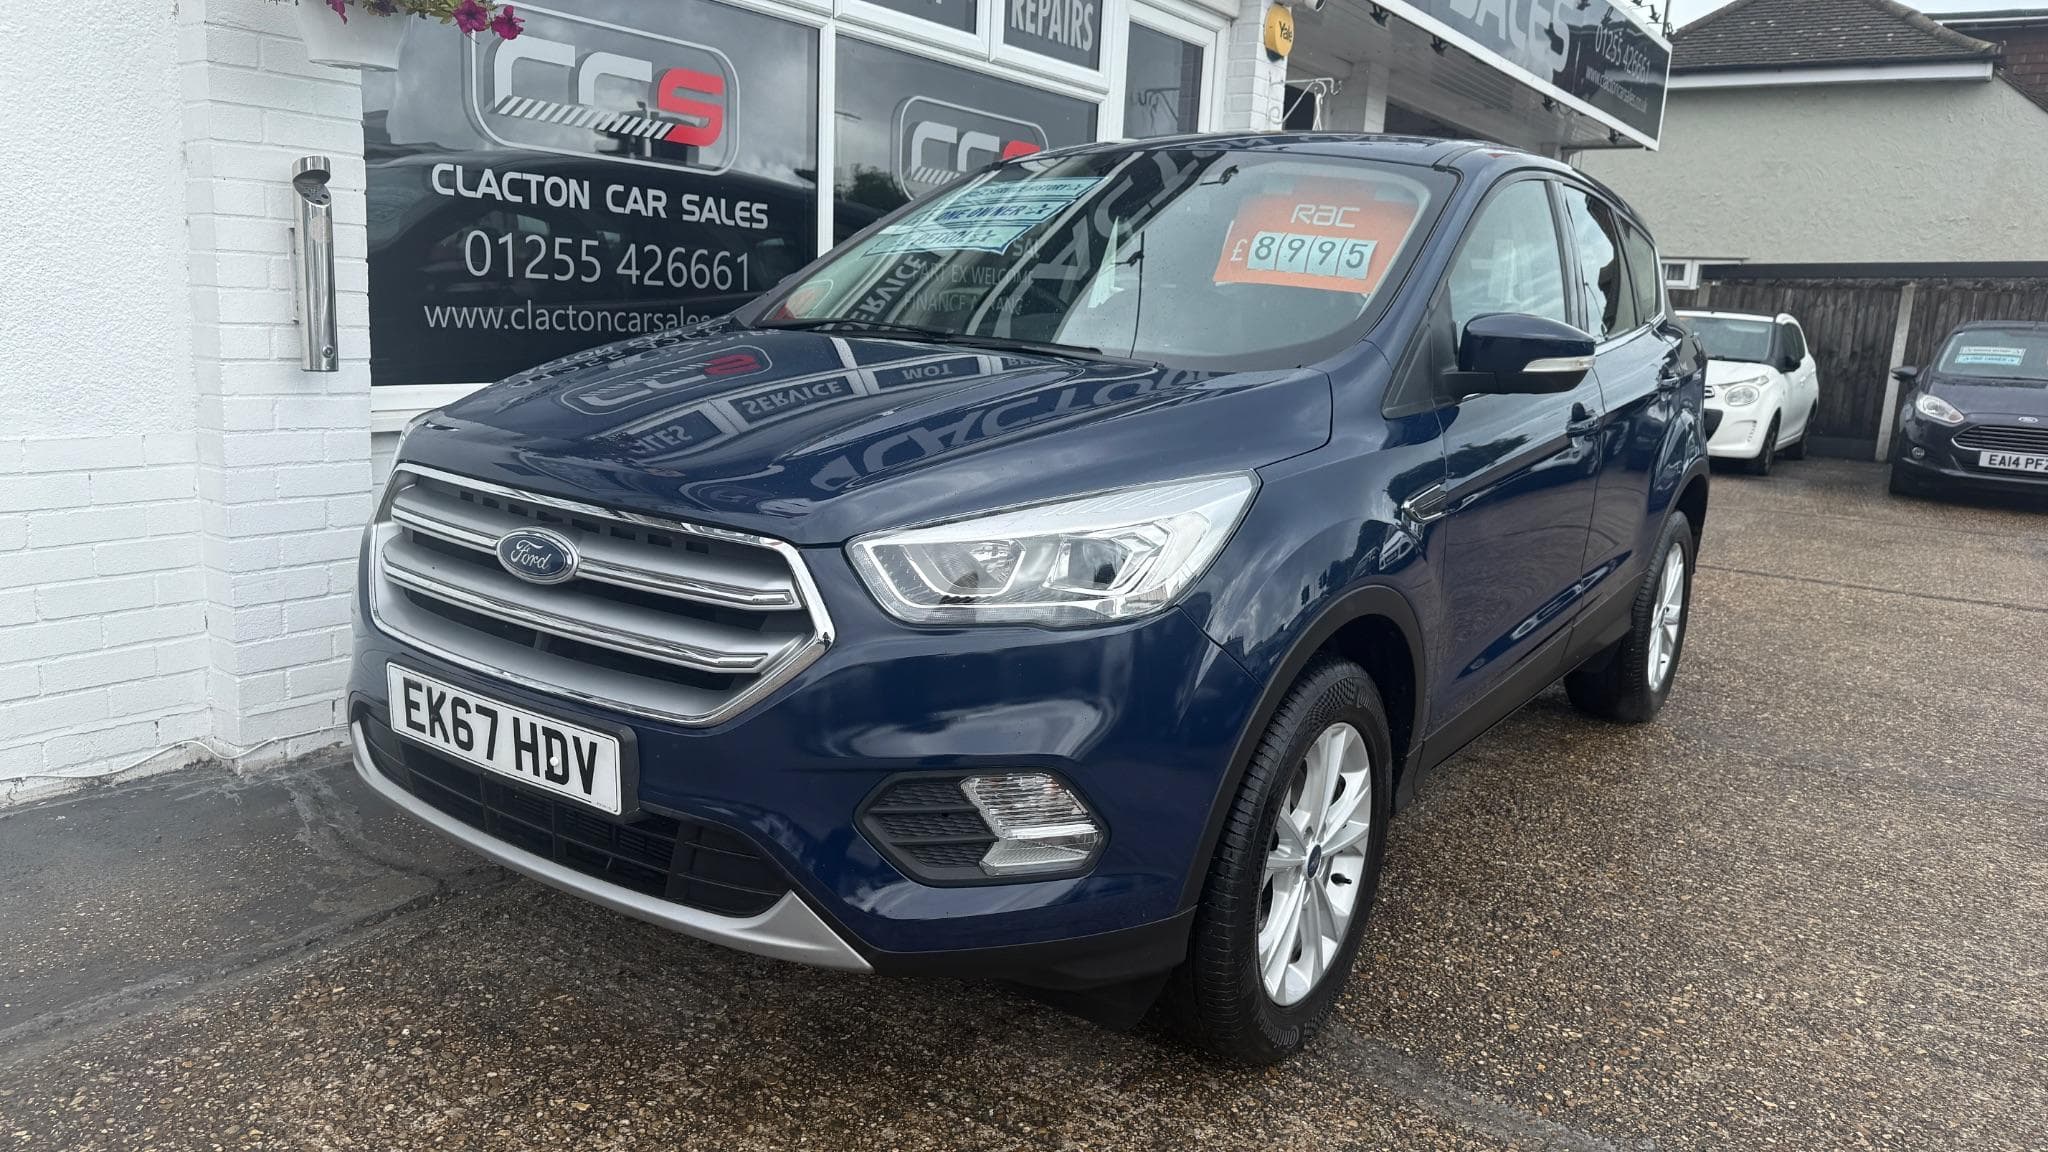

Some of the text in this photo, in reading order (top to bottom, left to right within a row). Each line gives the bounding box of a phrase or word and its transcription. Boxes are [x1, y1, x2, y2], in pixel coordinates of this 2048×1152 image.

[1011, 0, 1093, 51] REPAIRS
[1279, 21, 1292, 42] Yale
[1450, 0, 1570, 72] ALES
[1595, 24, 1651, 85] 01255 426661
[494, 36, 724, 147] CCS
[431, 163, 768, 229] CLACTON CAR SALES
[967, 205, 1028, 218] OWNER
[464, 230, 750, 291] 01255 426661
[951, 264, 969, 282] EX
[1254, 236, 1369, 269] 8995
[1988, 454, 2021, 468] EA14
[511, 539, 551, 571] Ford
[402, 676, 598, 795] EK67 HDV
